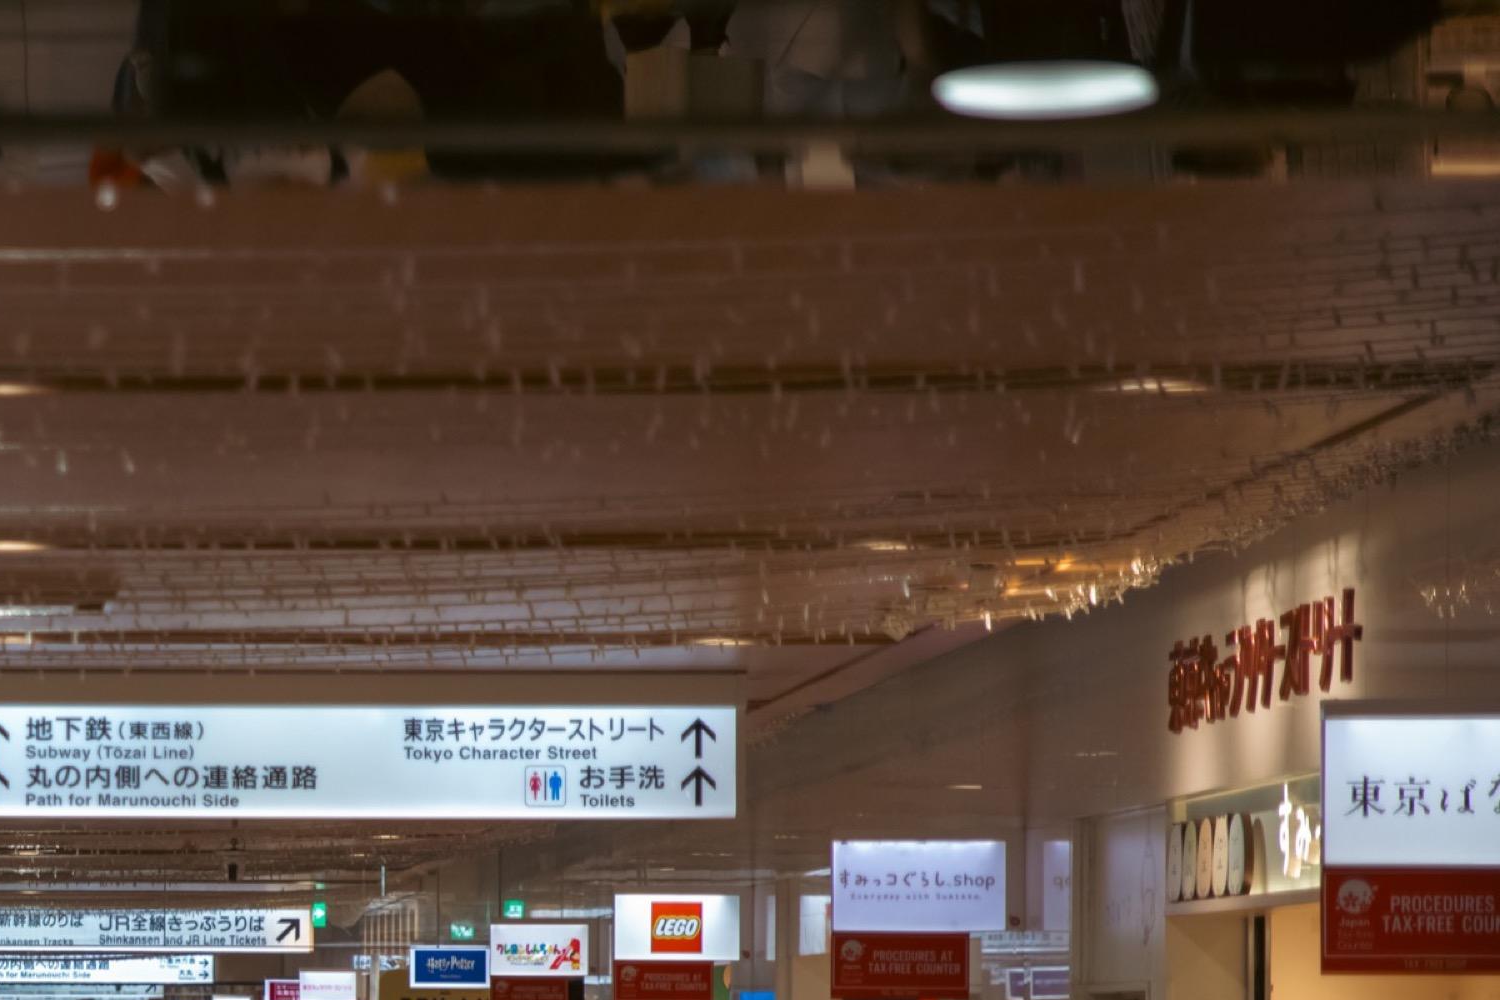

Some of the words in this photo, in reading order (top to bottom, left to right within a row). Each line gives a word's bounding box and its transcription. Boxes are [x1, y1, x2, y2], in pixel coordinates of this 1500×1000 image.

[403, 716, 665, 743] 東京キャラクターストリート
[25, 746, 91, 761] Subway
[153, 746, 195, 762] Line)
[404, 746, 454, 763] Tokyo
[459, 746, 542, 761] Character
[548, 746, 597, 761] Street
[26, 765, 317, 790] 丸の内側への連絡通路
[579, 765, 665, 790] お手洗
[25, 793, 63, 808] Path
[67, 793, 93, 808] for
[97, 793, 197, 808] Marunouchi
[202, 793, 240, 808] Side
[579, 793, 636, 808] Toilets
[1390, 895, 1495, 913] PROCEDURES
[99, 914, 265, 932] JR全線きっぷうりば
[655, 918, 699, 936] LEGO
[99, 934, 160, 945] Shinkansen
[185, 934, 200, 945] JR
[203, 934, 226, 945] Line
[229, 934, 267, 945] Tickets
[873, 950, 936, 962] PROCEDURES
[940, 950, 954, 962] AT
[916, 963, 961, 975] COUNTER
